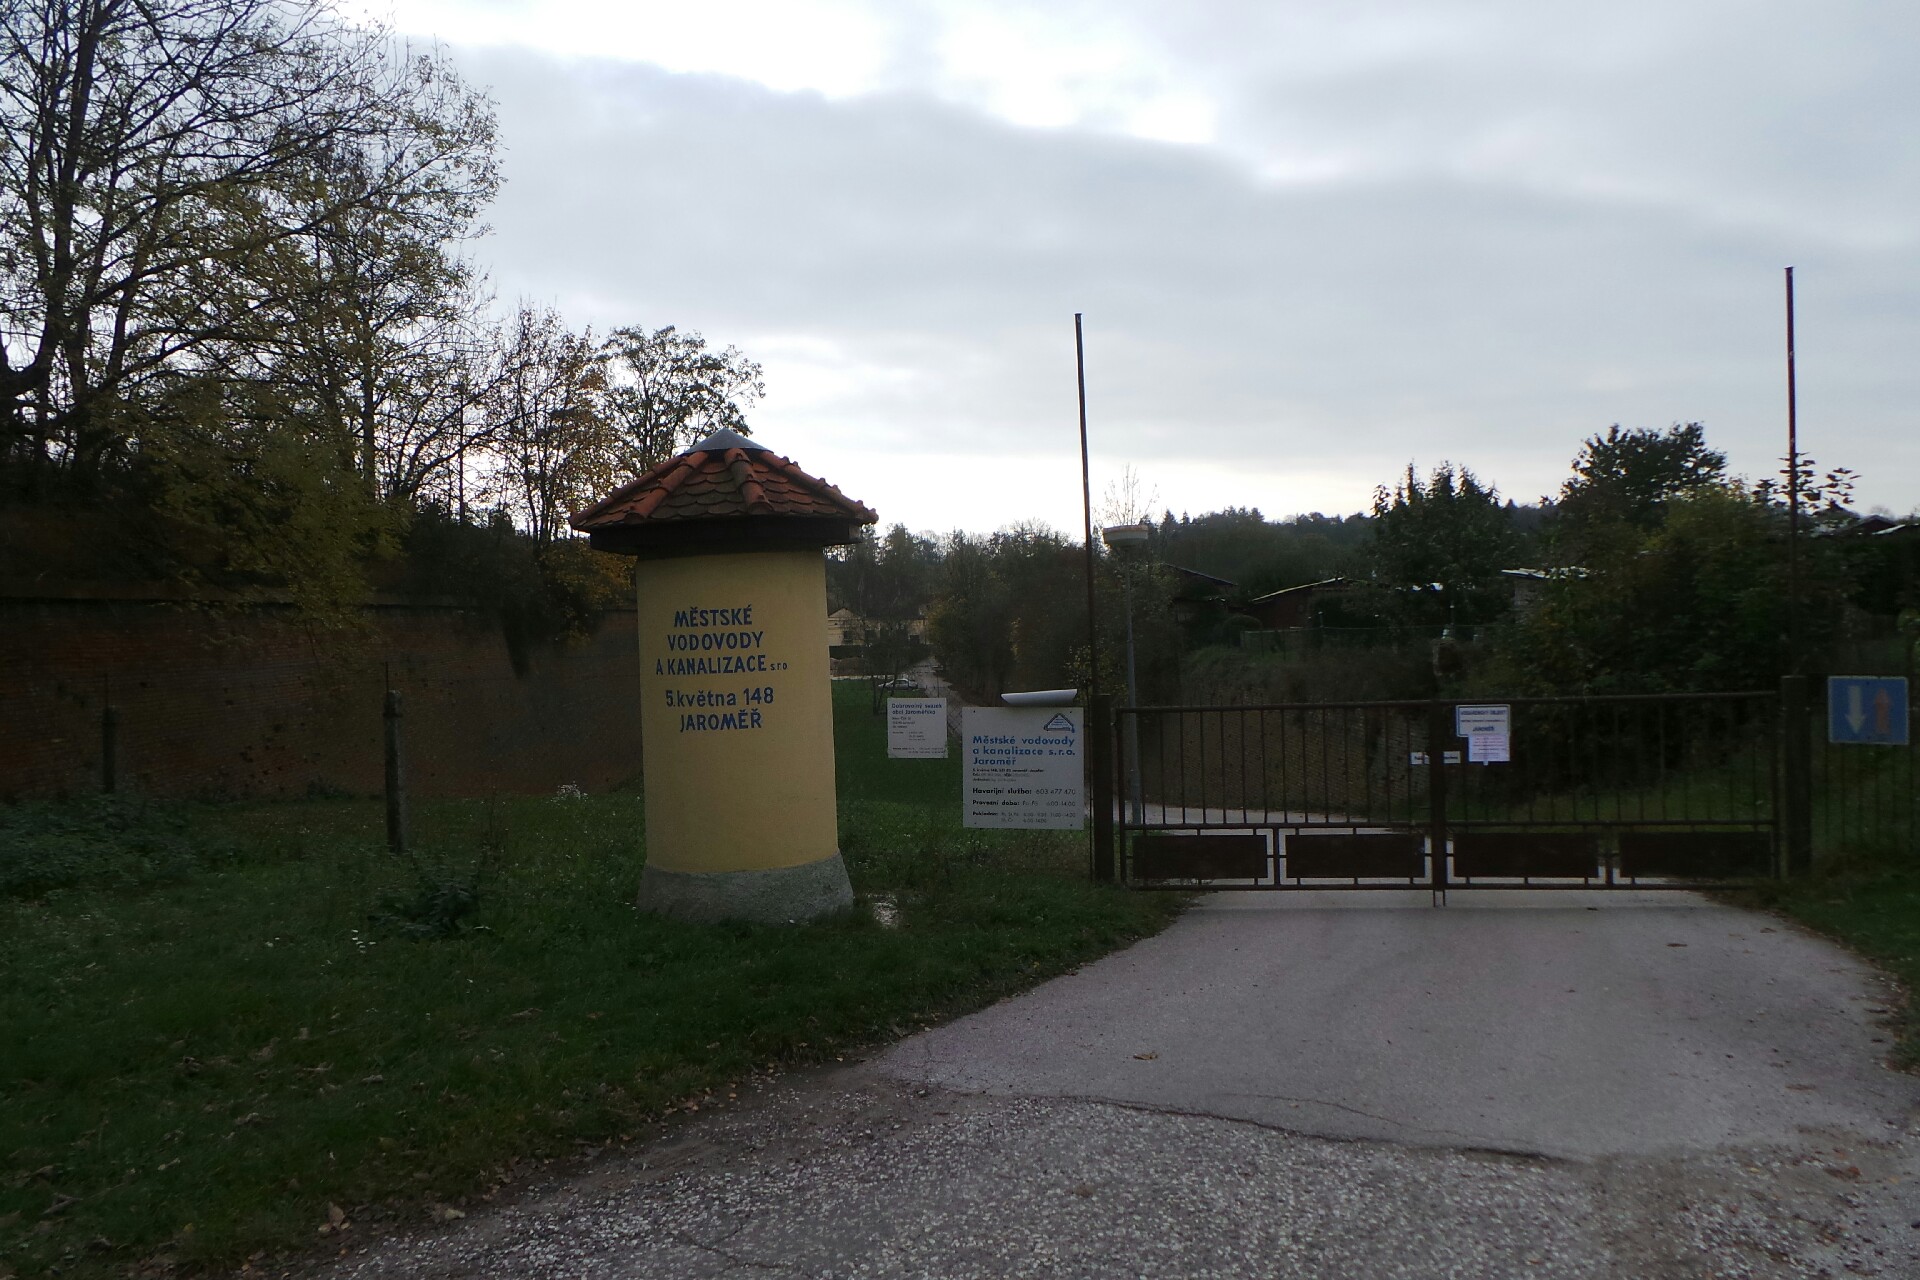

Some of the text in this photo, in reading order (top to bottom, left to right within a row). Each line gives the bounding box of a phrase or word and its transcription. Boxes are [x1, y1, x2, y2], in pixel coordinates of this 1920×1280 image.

[674, 604, 752, 627] MĚSTSKÉ
[667, 631, 763, 651] VODOVODY
[656, 658, 663, 675] A
[667, 655, 767, 675] KANALIZACE
[743, 687, 774, 705] 148
[680, 708, 762, 733] JAROMĚŘ
[972, 735, 1075, 747] Městské vodovody
[983, 746, 1043, 755] kanalizace
[973, 757, 1016, 765] Jaroměř
